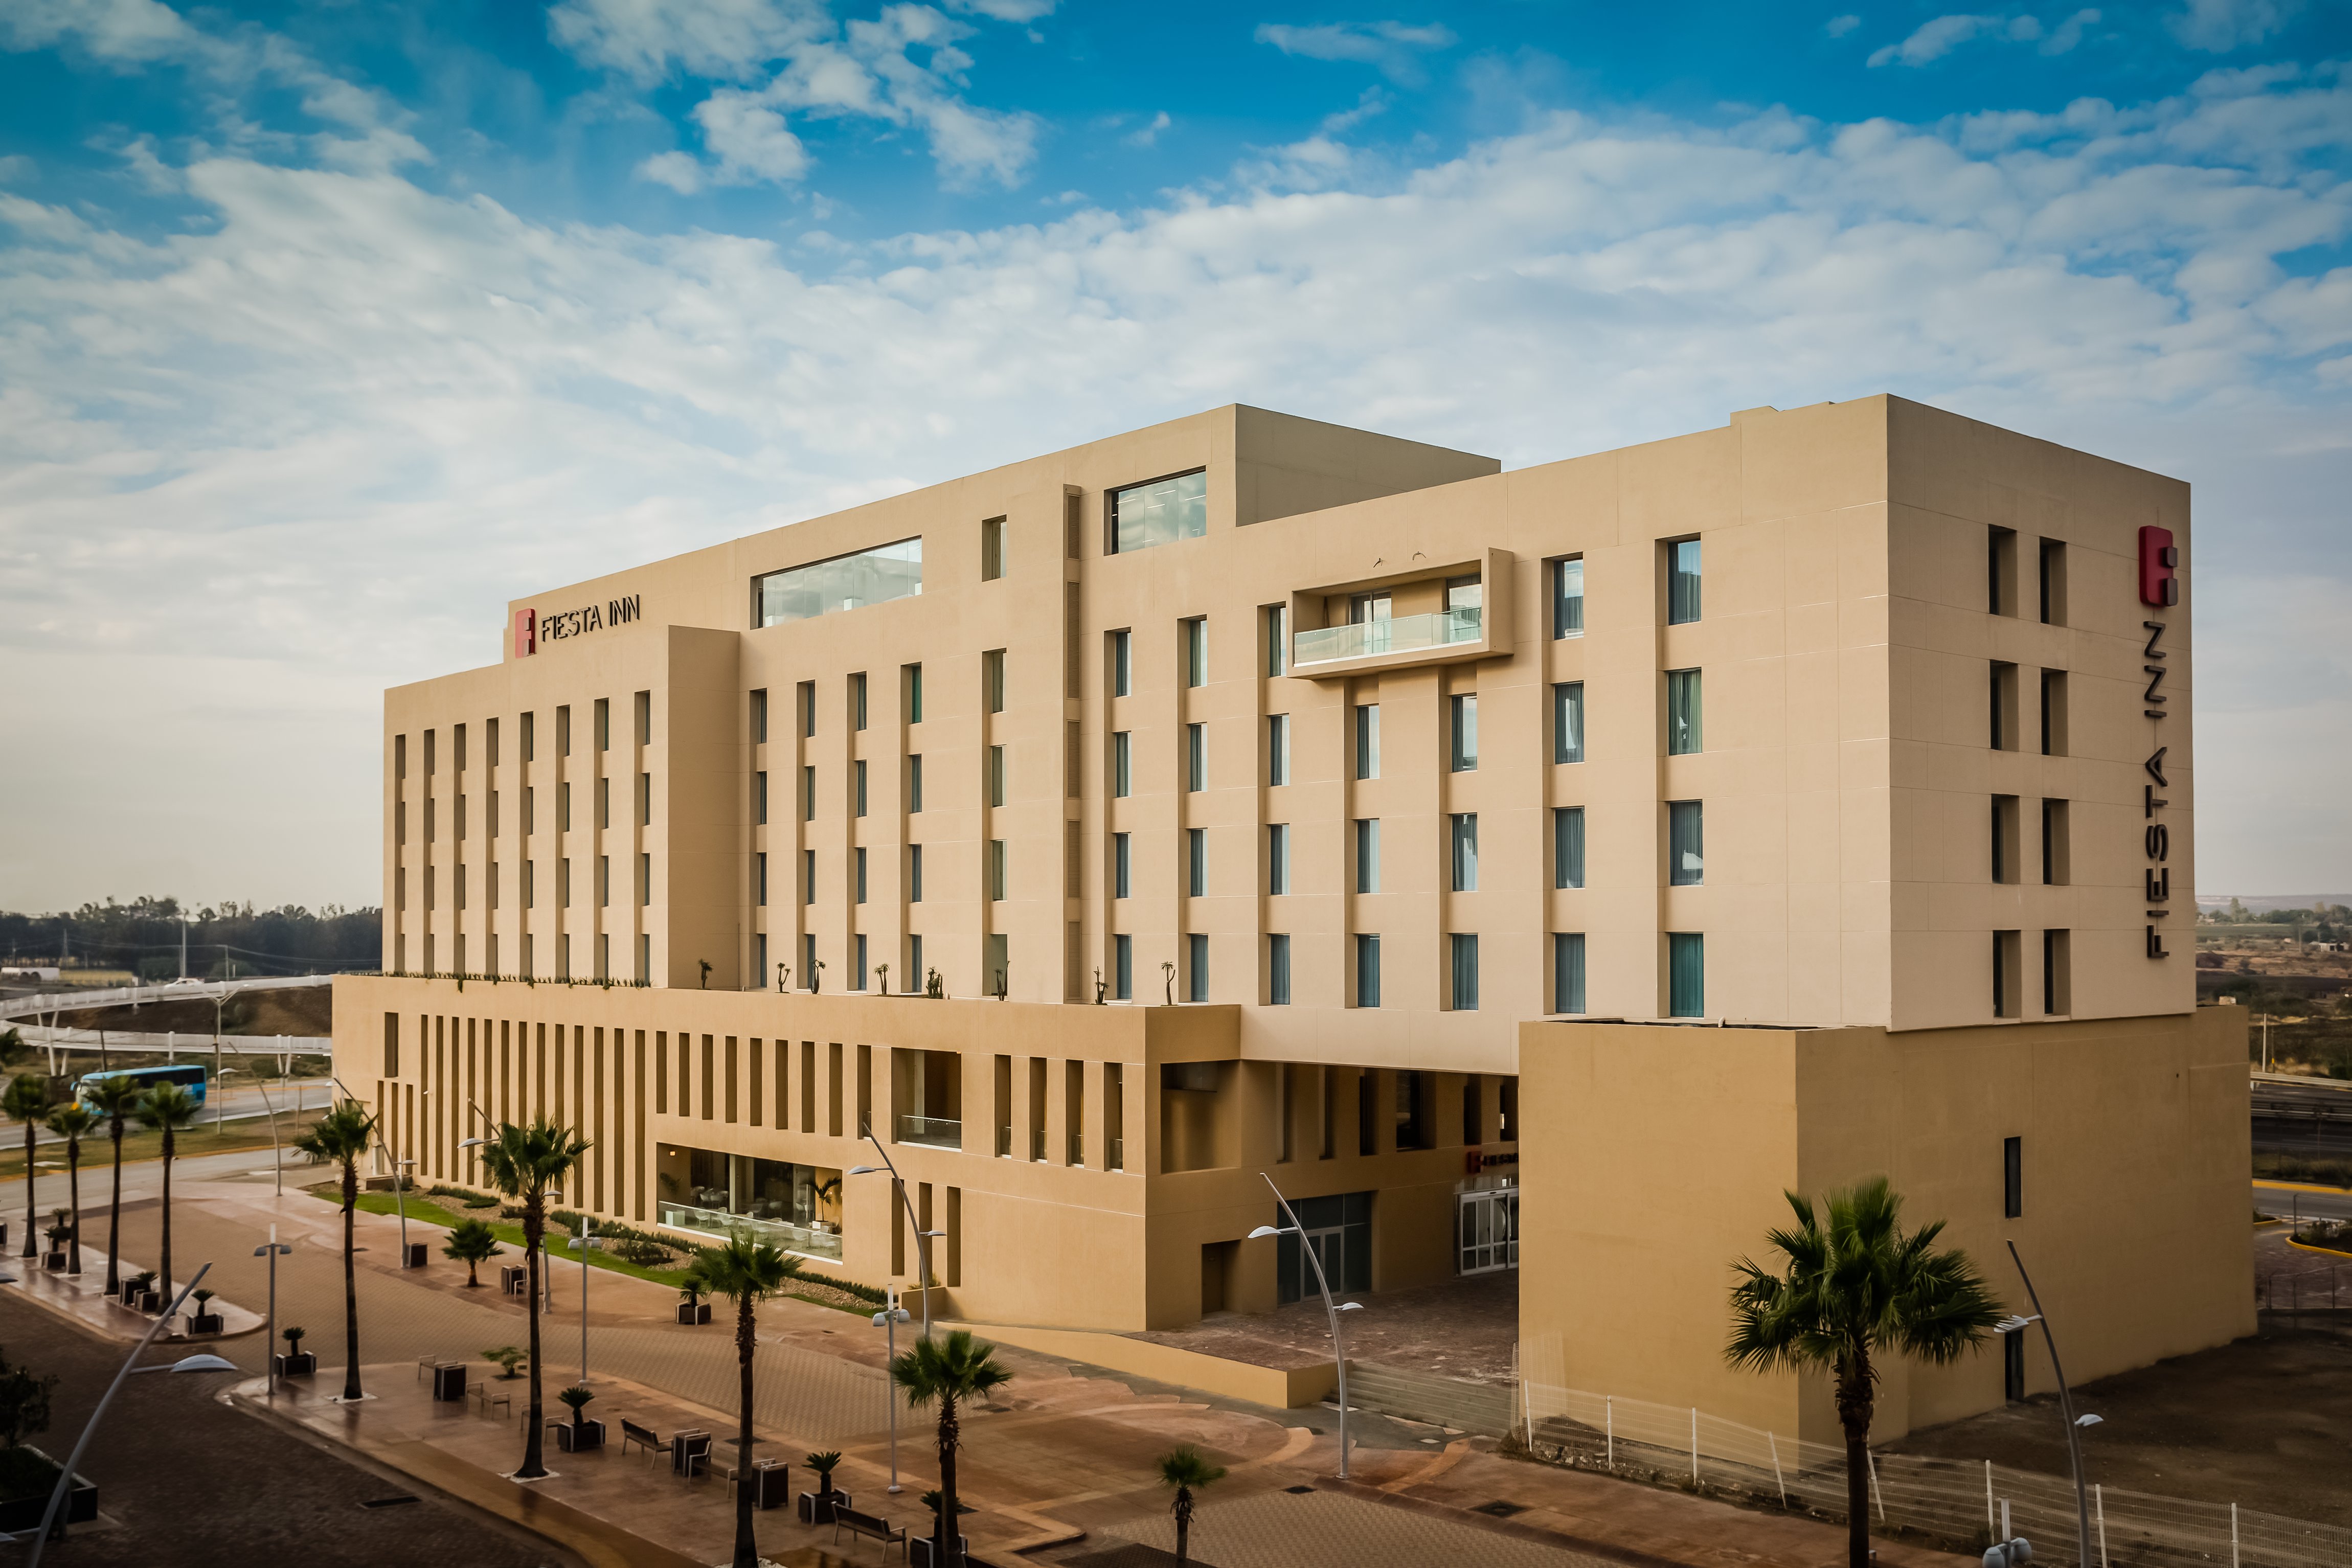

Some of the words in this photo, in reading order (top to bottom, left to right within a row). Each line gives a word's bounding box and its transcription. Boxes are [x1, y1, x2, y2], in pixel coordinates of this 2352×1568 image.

[541, 605, 603, 642] FIESTA
[608, 594, 640, 627] INN
[2143, 621, 2167, 717] INN
[2145, 746, 2169, 959] FIESTA
